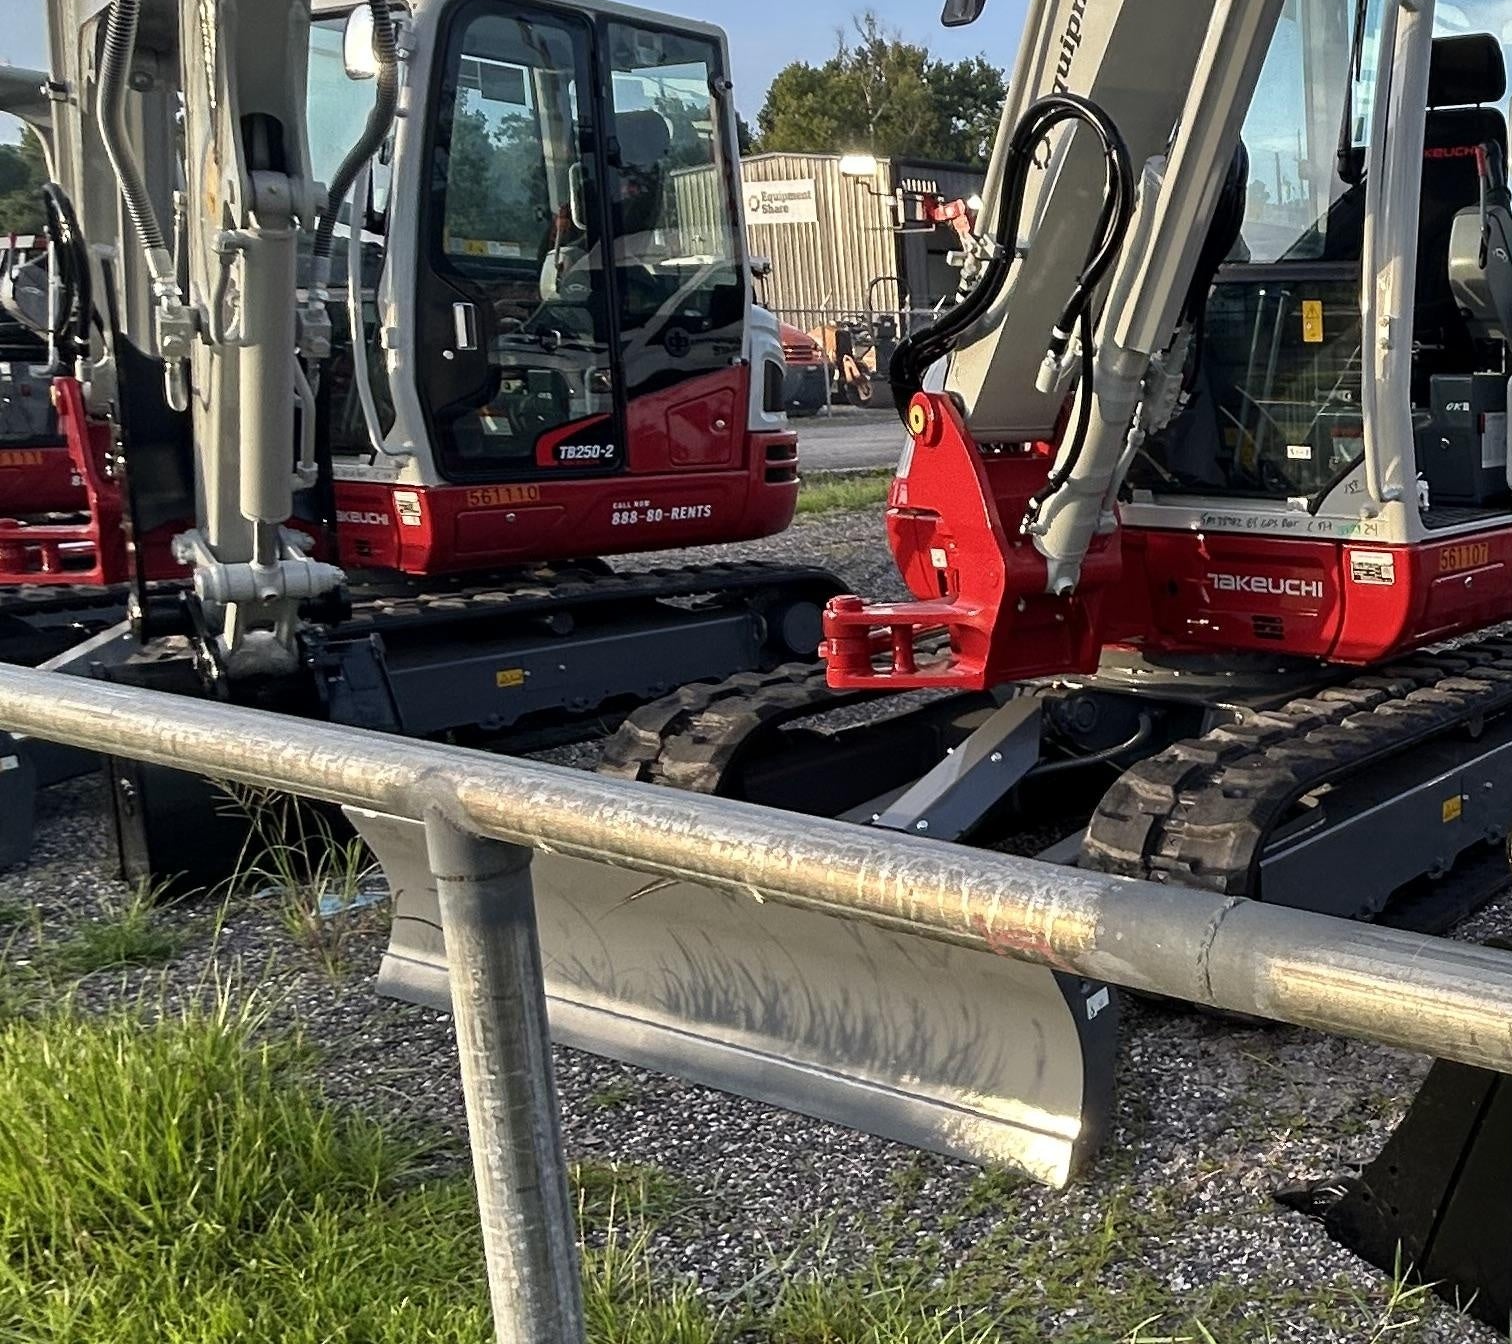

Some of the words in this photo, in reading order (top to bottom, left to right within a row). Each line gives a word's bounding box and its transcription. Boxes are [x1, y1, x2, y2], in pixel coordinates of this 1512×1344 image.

[761, 190, 812, 203] Equipment
[762, 205, 789, 214] Share
[559, 444, 615, 460] TB250-2
[469, 487, 538, 506] 561110
[611, 504, 712, 526] 888-80-RENTS
[1207, 572, 1324, 598] TAKEUCHI
